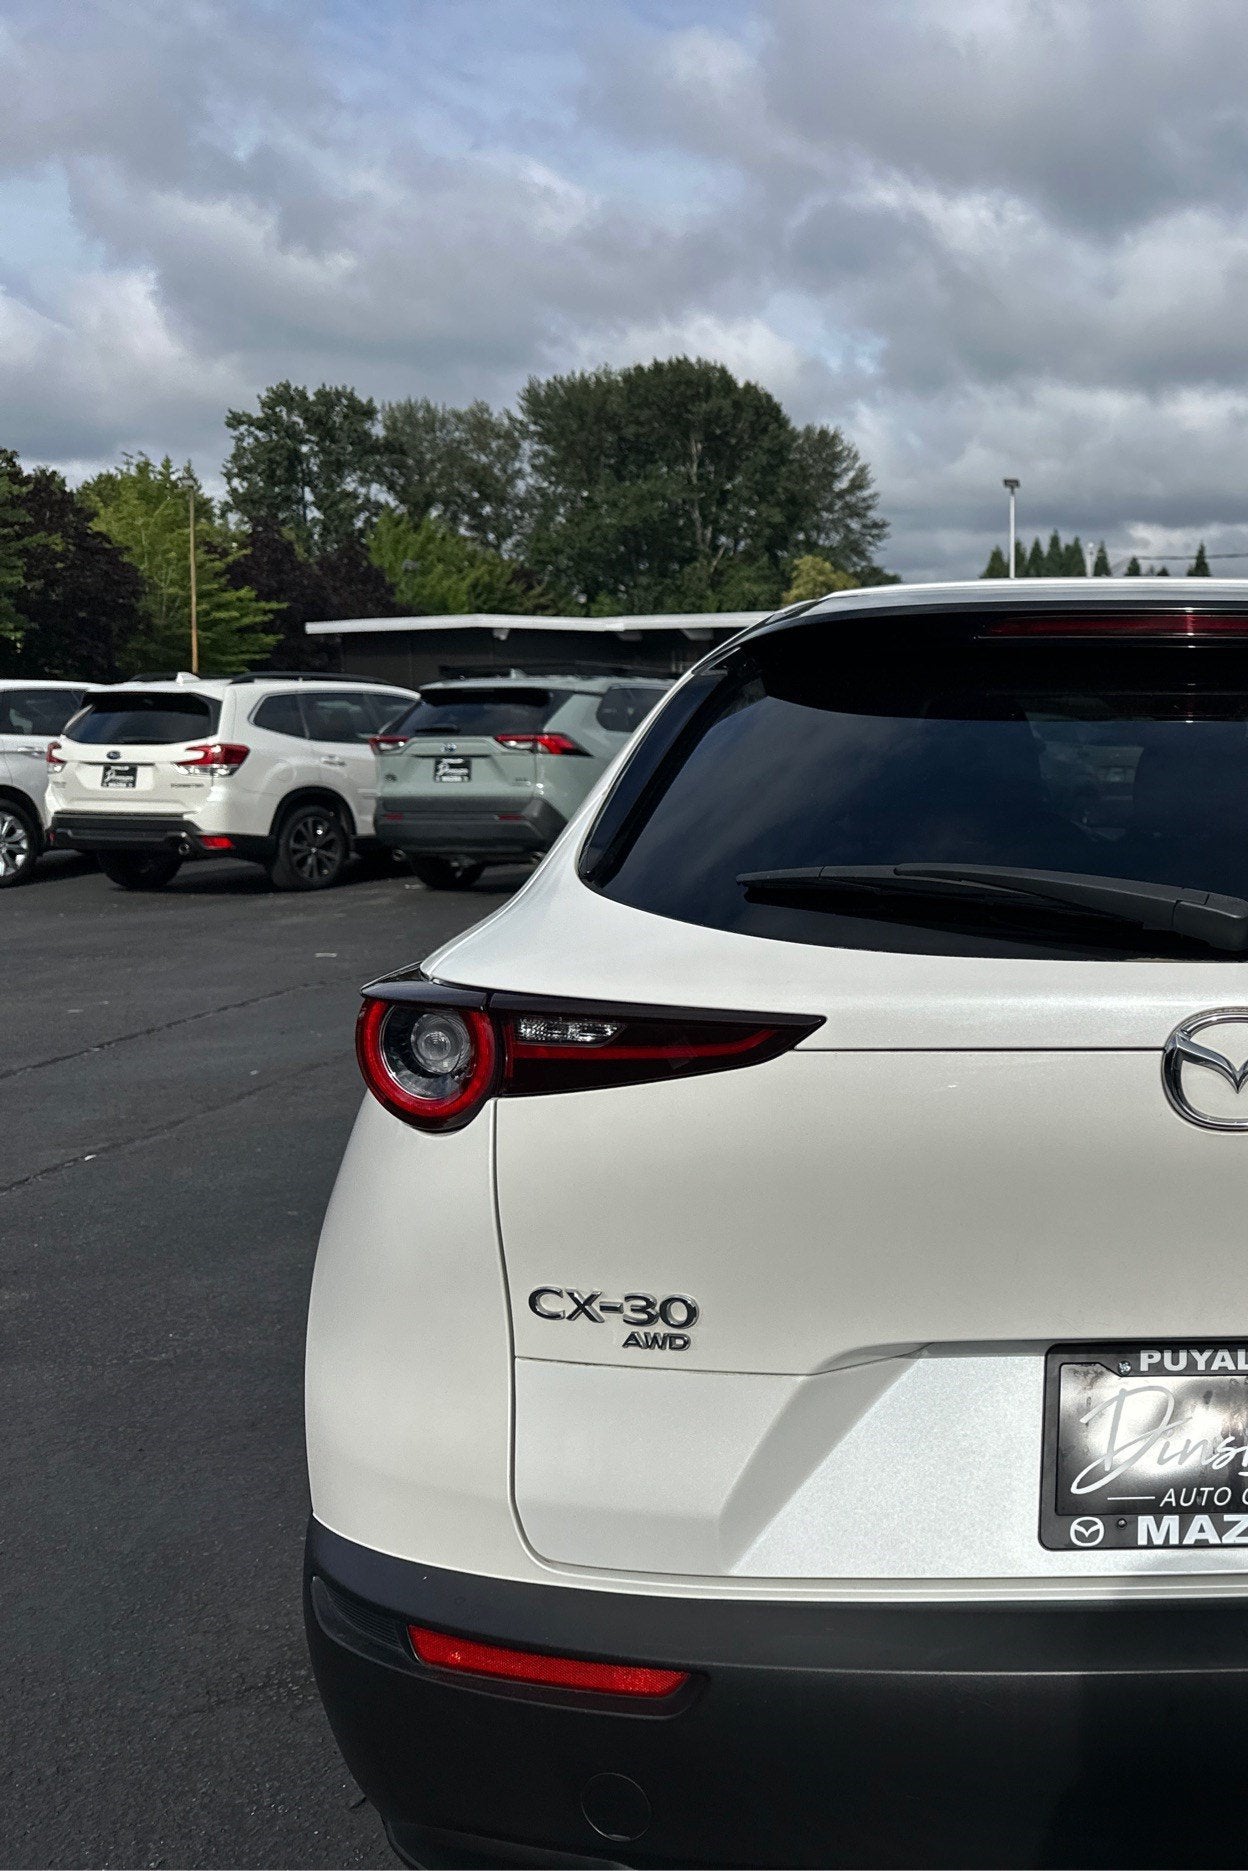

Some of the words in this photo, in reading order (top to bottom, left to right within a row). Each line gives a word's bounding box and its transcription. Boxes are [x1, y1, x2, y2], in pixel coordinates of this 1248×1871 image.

[528, 1286, 700, 1329] CX-30
[622, 1331, 692, 1351] AWD
[1159, 1487, 1232, 1507] AUTO
